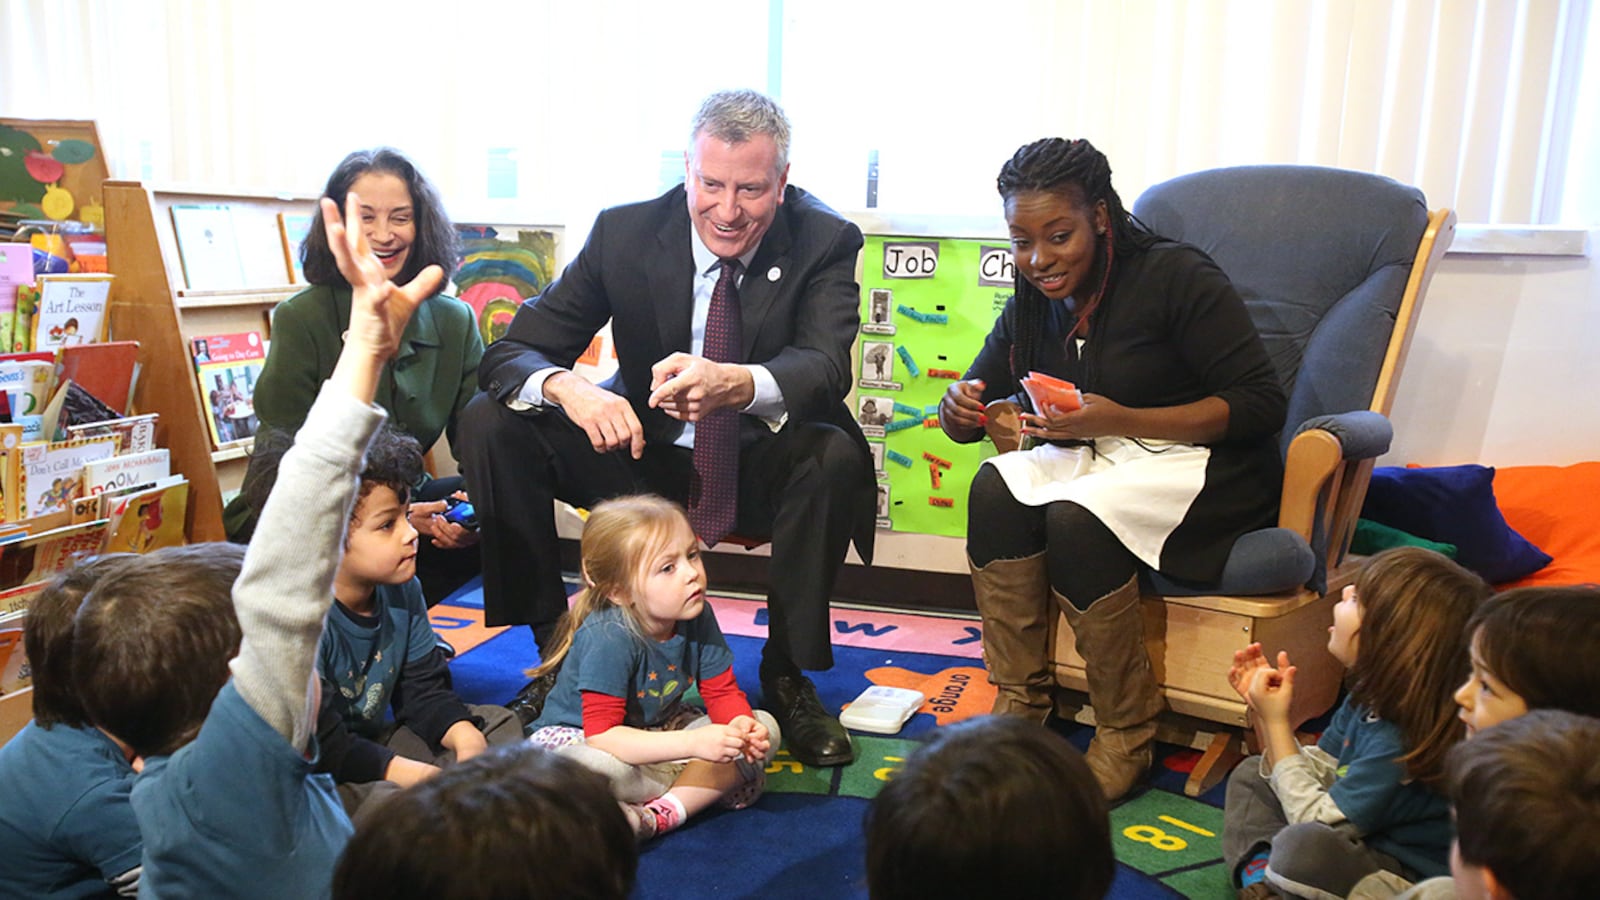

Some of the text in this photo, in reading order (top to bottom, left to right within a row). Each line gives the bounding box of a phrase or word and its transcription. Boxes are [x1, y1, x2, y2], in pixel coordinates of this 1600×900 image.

[886, 249, 1015, 278] Job Ch
[70, 287, 84, 298] The
[46, 299, 102, 314] Art Lesson
[0, 369, 25, 383] euss's
[30, 464, 51, 476] Don't
[53, 459, 69, 472] Call
[928, 674, 971, 713] orange
[1122, 815, 1216, 851] 18
